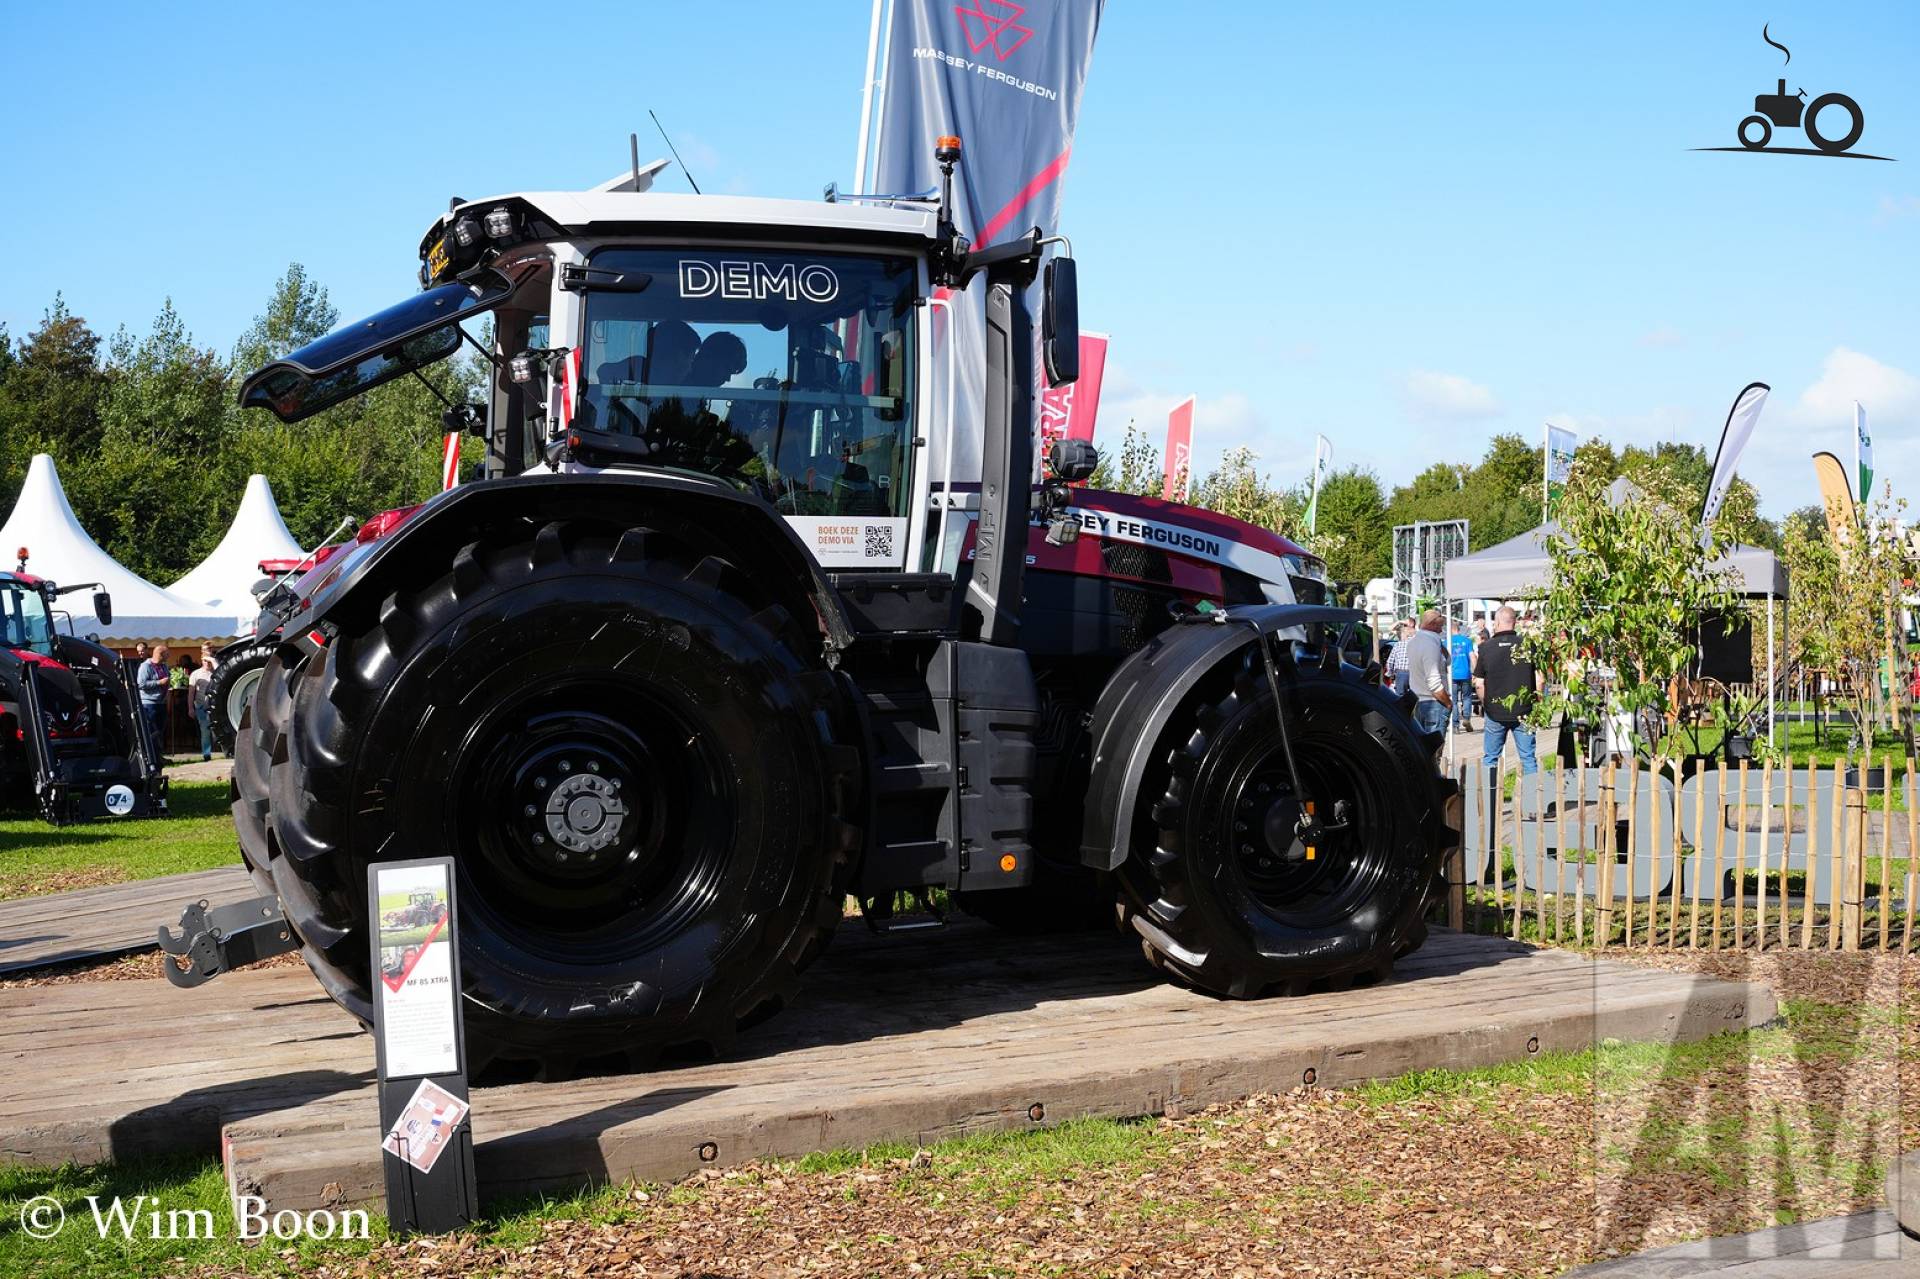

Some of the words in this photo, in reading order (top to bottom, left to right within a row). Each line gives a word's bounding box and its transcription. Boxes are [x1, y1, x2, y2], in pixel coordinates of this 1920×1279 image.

[913, 47, 974, 71] MASSEY
[977, 65, 1056, 101] FERGUSON
[678, 259, 839, 302] DEMO
[818, 526, 838, 535] BOEK
[841, 526, 859, 535] DEZE
[818, 536, 840, 545] DEMO
[842, 536, 855, 545] VIA
[1117, 521, 1220, 556] FERGUSON
[431, 976, 449, 984] XTRA
